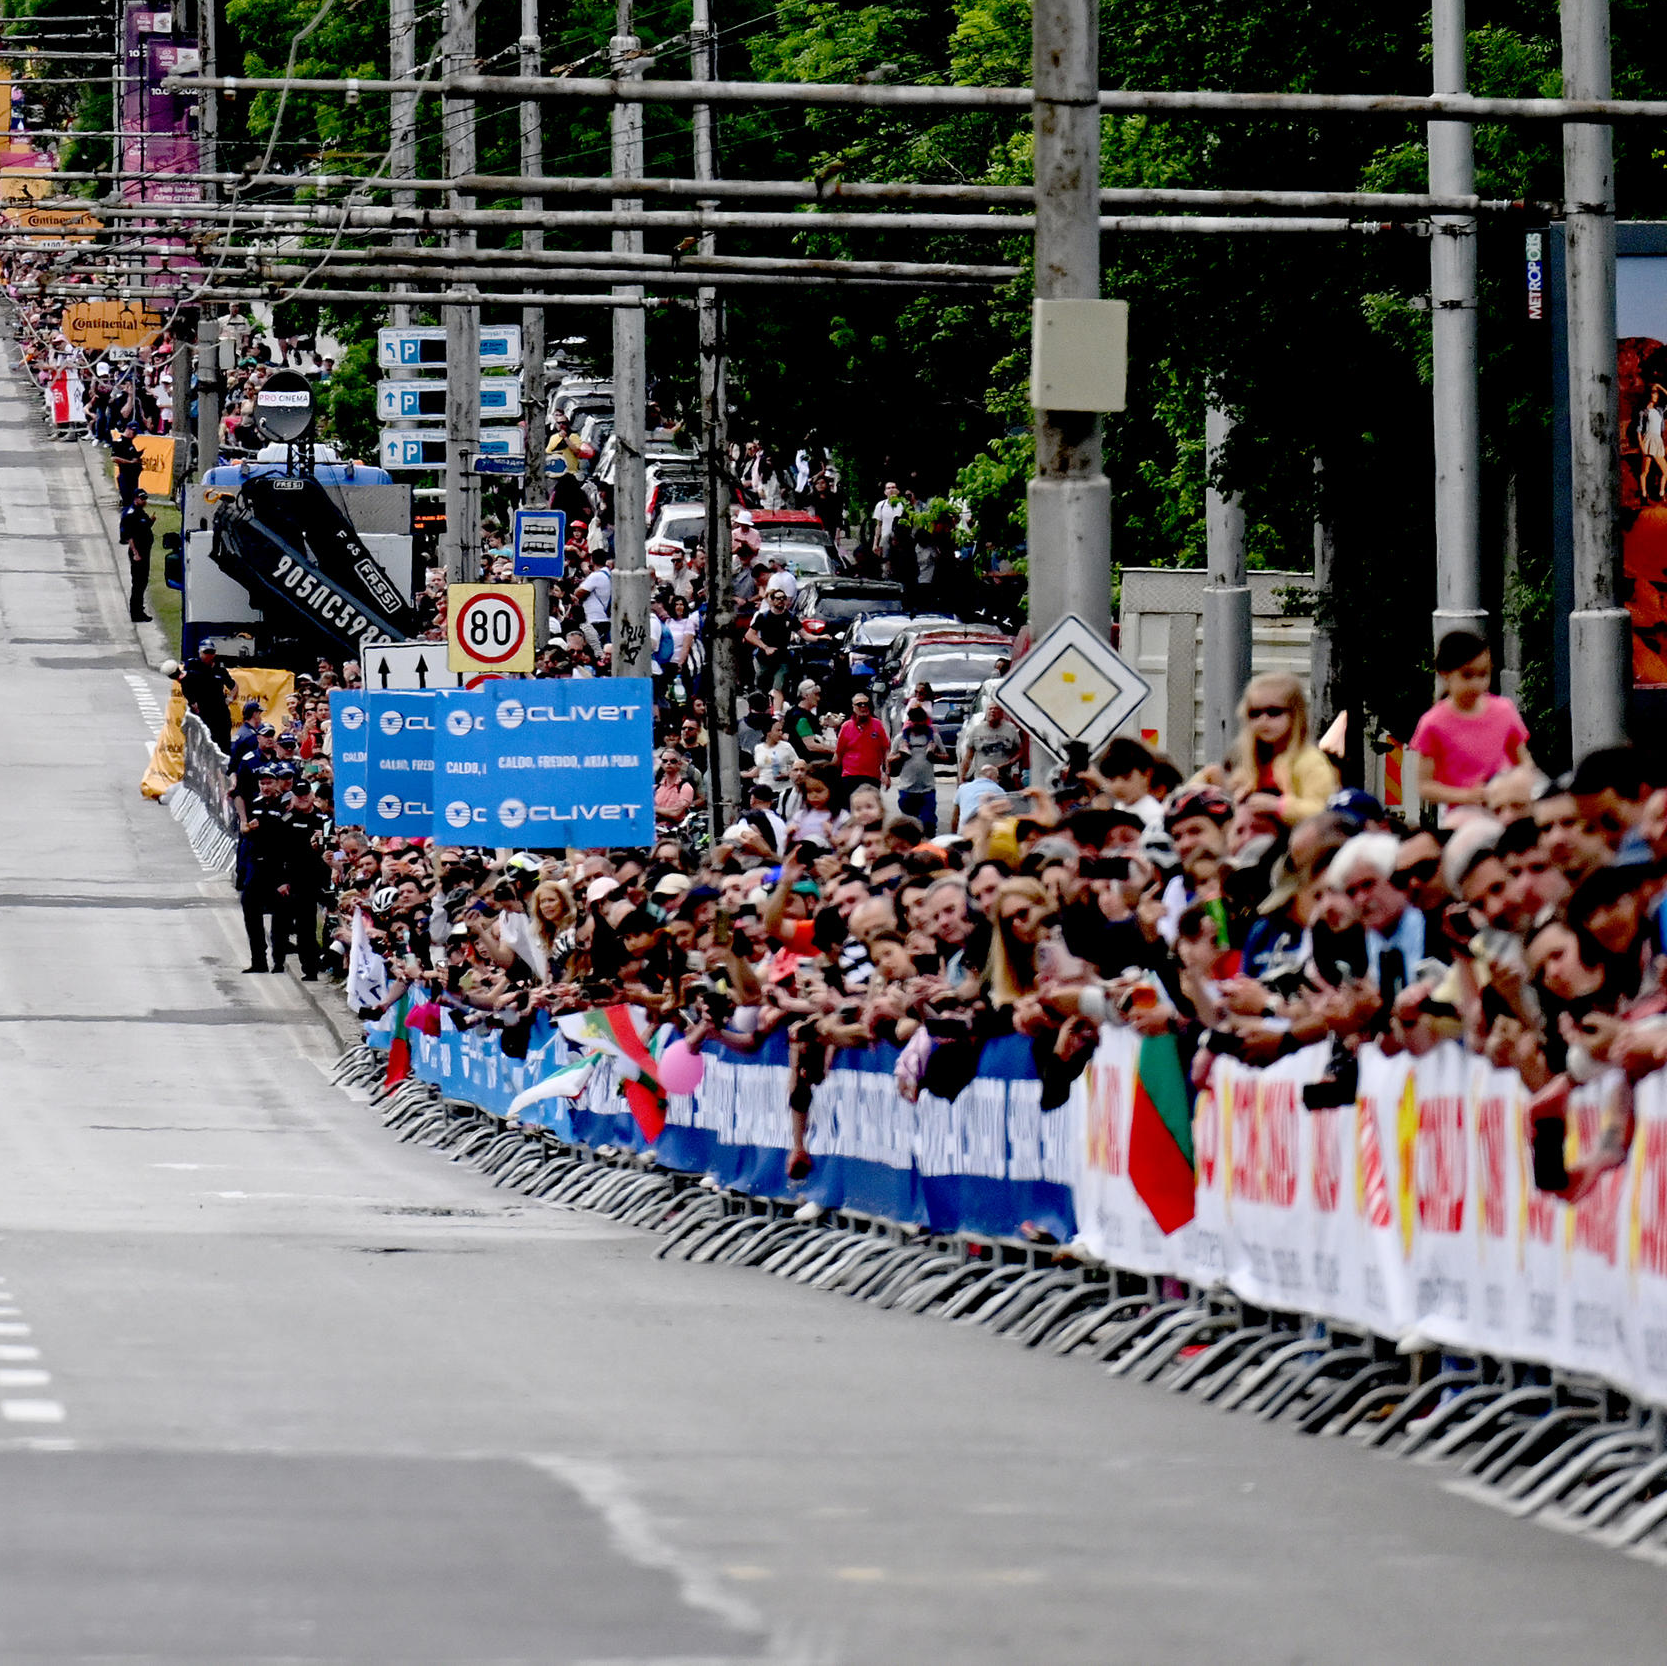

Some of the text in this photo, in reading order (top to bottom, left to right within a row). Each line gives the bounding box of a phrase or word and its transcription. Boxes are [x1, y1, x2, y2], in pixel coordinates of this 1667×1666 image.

[72, 317, 137, 331] Continental
[404, 343, 415, 360] P
[258, 394, 308, 402] PRO CINEMA
[404, 395, 415, 411] P
[406, 444, 418, 460] P
[275, 481, 301, 489] FASSI
[336, 530, 347, 538] F
[360, 564, 397, 608] FASSI
[470, 609, 511, 646] 80
[527, 705, 641, 722] CLIVET
[412, 759, 435, 771] FRED
[528, 804, 642, 821] CLIVET
